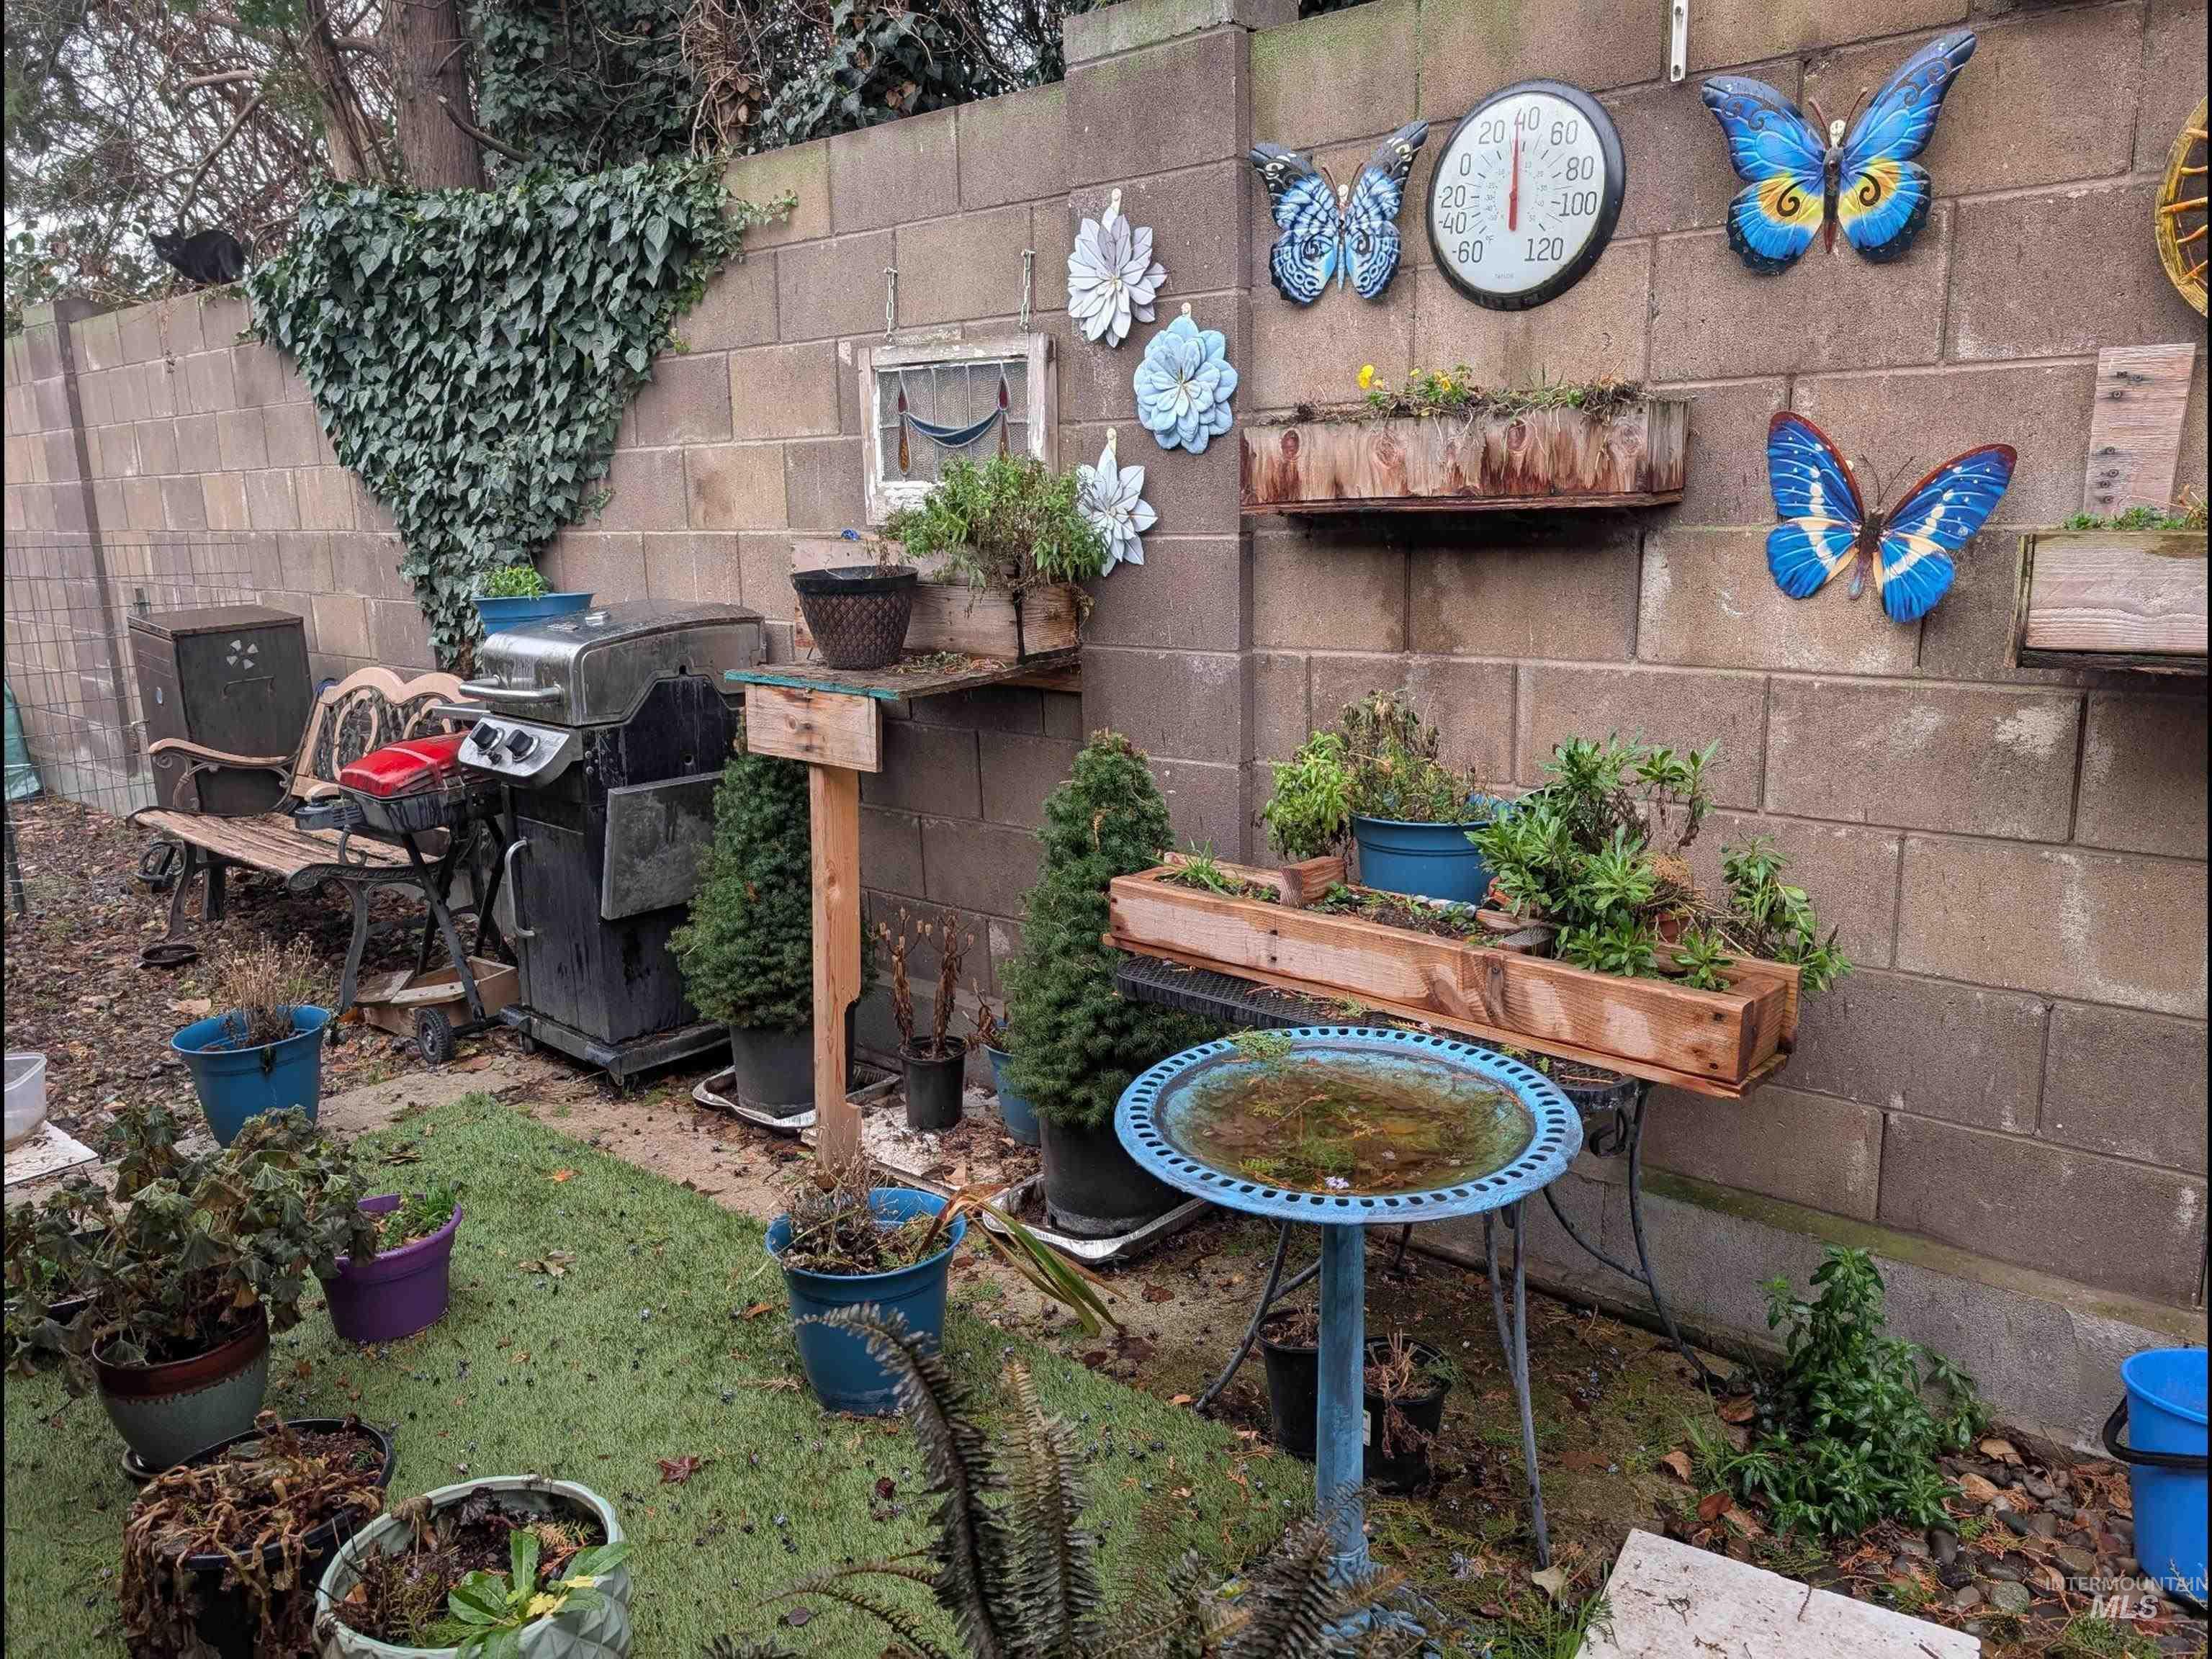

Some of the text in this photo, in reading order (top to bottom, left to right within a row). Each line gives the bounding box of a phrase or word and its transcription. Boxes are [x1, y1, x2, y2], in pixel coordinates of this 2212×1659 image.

[1514, 107, 1540, 131] 40
[1479, 120, 1504, 144] 20
[1550, 120, 1578, 145] 60
[1460, 153, 1471, 176] 0
[1566, 156, 1594, 181] 80
[1559, 191, 1597, 217] 100
[1524, 237, 1564, 261] 120
